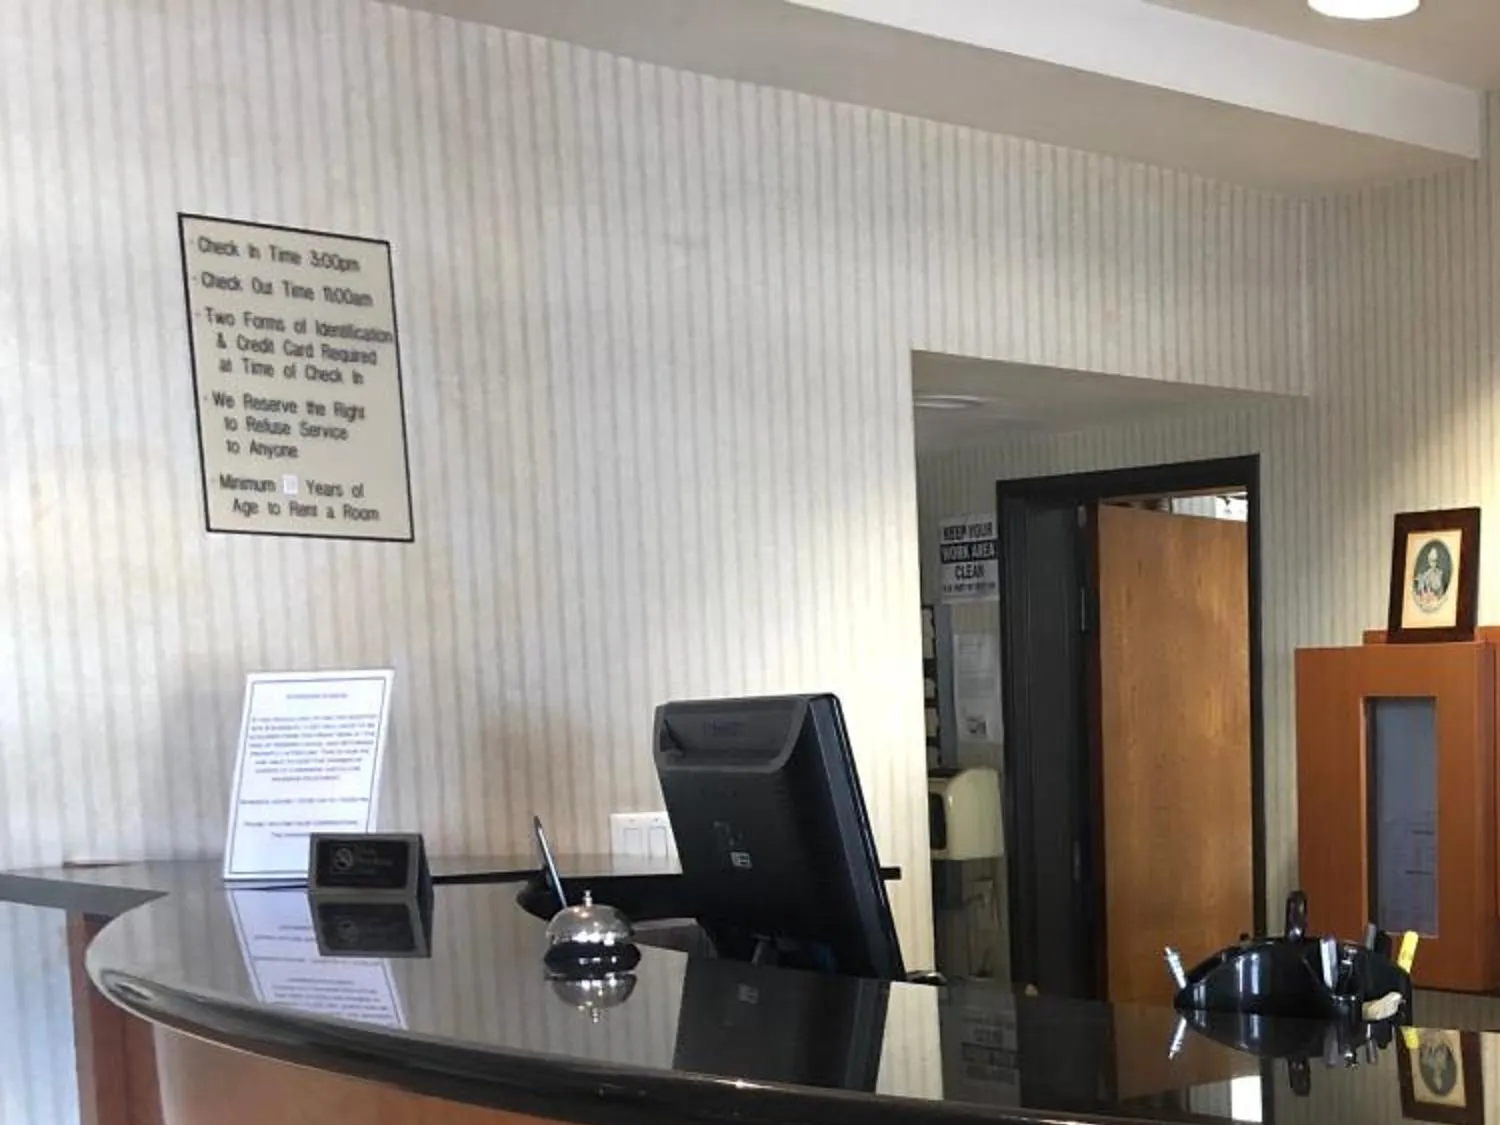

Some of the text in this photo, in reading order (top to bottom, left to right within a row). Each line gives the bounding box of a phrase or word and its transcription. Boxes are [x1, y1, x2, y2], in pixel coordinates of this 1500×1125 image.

[198, 236, 240, 256] Check
[248, 244, 261, 260] In
[269, 244, 302, 265] Time
[201, 271, 243, 292] Check
[251, 276, 273, 295] Out
[281, 280, 315, 301] Time
[205, 306, 394, 343] Two Forms of Identification
[216, 332, 377, 366] & Credit Card Required
[219, 357, 364, 385] at Time of Check In
[212, 390, 366, 423] We Reserve the Right
[224, 416, 348, 440] to Refuse Service
[226, 439, 299, 459] to Anyone
[219, 472, 365, 498] Minimum Years of
[232, 498, 381, 522] Age to Rent a Room
